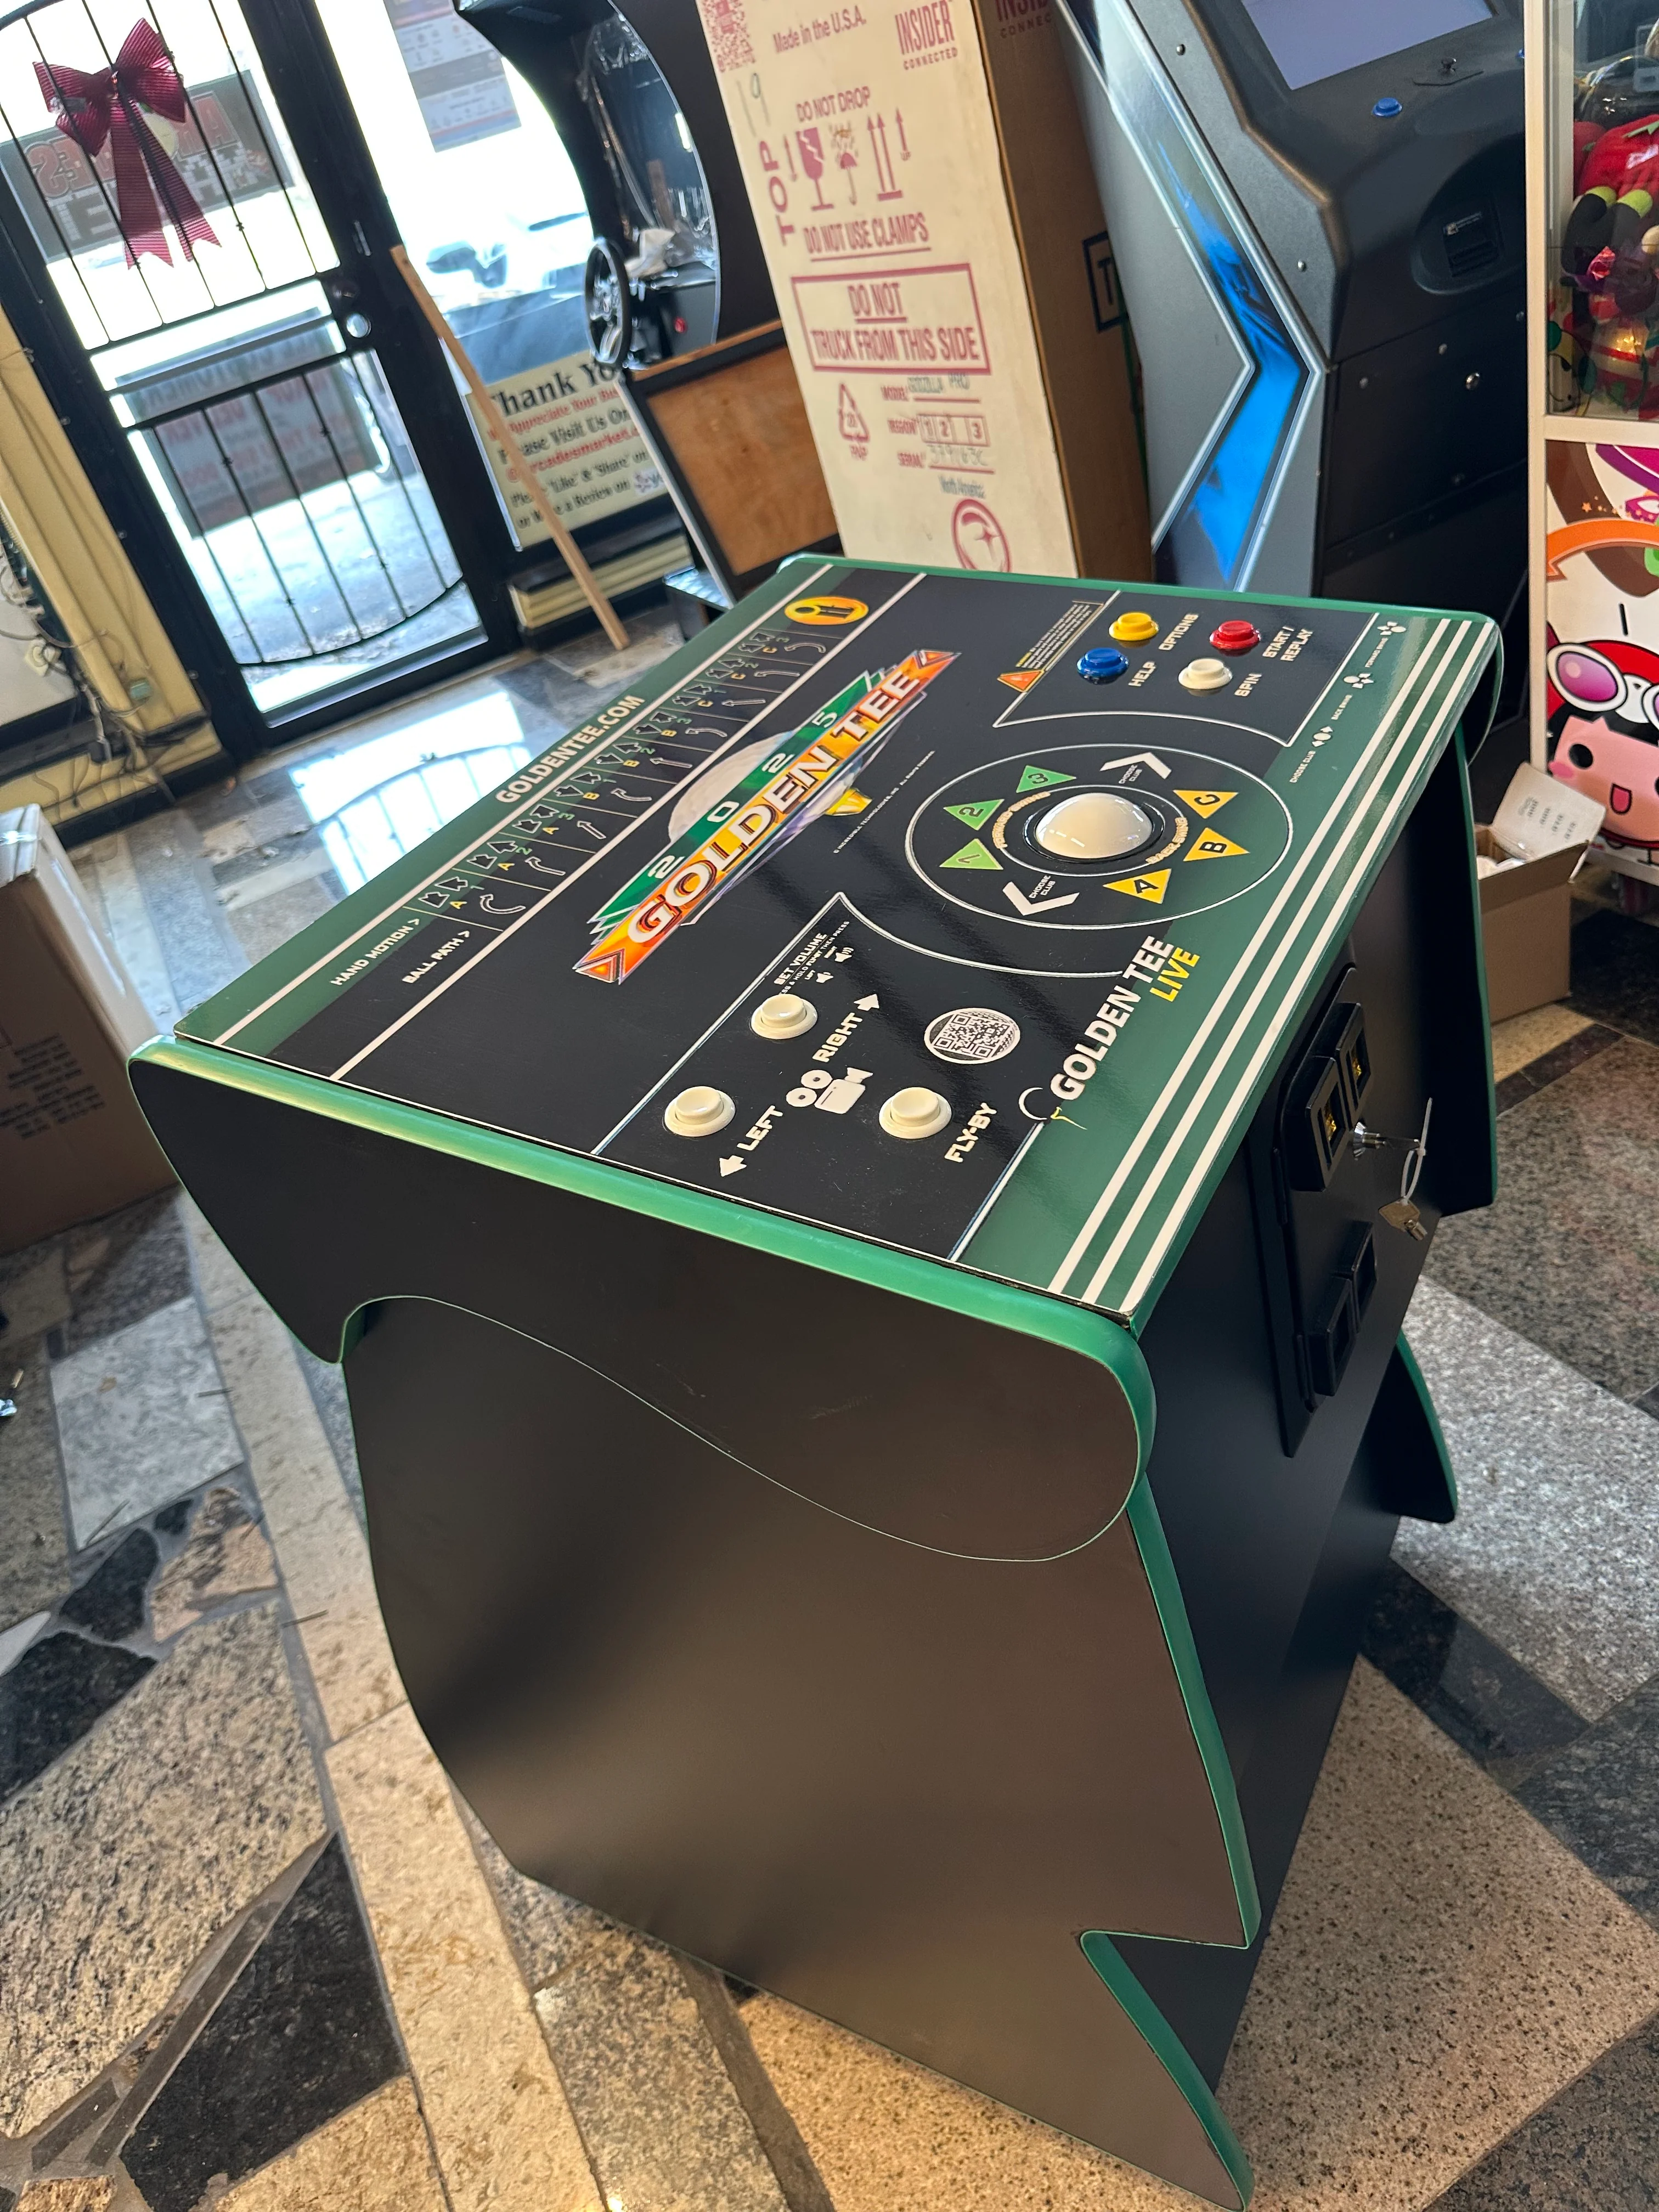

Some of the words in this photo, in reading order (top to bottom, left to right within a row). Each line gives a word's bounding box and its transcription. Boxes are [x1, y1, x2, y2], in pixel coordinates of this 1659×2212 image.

[772, 32, 800, 53] Made
[830, 5, 867, 33] U.S.A.
[895, 0, 955, 55] INSIDER
[903, 47, 958, 70] CONNECTED
[796, 101, 813, 122] DO
[812, 94, 836, 117] NOT
[838, 86, 871, 112] DROP
[759, 140, 795, 247] TOP
[803, 227, 822, 254] DO
[821, 223, 846, 252] NOT
[845, 220, 873, 250] USE
[872, 212, 929, 247] CLAMPS
[847, 284, 872, 317] DO
[870, 282, 903, 316] NOT
[810, 329, 856, 360] TRUCK
[854, 329, 900, 361] FROM
[897, 328, 938, 361] THIS
[937, 327, 980, 361] SIDE
[493, 372, 578, 417] hank
[1158, 613, 1200, 651] OPTIONS
[1262, 630, 1291, 658] START
[1280, 628, 1314, 661] REPLAY
[1128, 661, 1157, 687] HELP
[1234, 672, 1262, 697] SPIN
[495, 695, 646, 803] GOLDENTEE.COM
[623, 759, 640, 768] B
[583, 792, 600, 800] B
[1027, 773, 1048, 785] 3
[628, 744, 840, 943] GOLDEN
[830, 671, 920, 741] TEE
[958, 806, 984, 817] 2
[1193, 793, 1221, 806] C
[542, 827, 560, 835] A
[557, 812, 575, 820] 3
[497, 862, 515, 871] A
[514, 847, 533, 855] 2
[957, 854, 981, 864] 1
[1198, 841, 1227, 854] B
[1029, 875, 1051, 899] CHOOSE
[1040, 881, 1056, 895] CLUB
[1133, 878, 1159, 894] A
[449, 901, 467, 910] A
[330, 959, 369, 985] HAND
[365, 926, 414, 959] MOTION
[402, 961, 437, 984] BALL
[431, 938, 465, 960] PATH
[774, 967, 794, 985] SET
[789, 933, 827, 966] VOLUME
[1149, 947, 1200, 1002] LIVE
[1050, 985, 1141, 1101] GOLDEN
[1122, 935, 1175, 984] TEE
[812, 1012, 863, 1063] RIGHT
[737, 1105, 783, 1152] LEFT
[944, 1102, 997, 1163] FLY-BY
